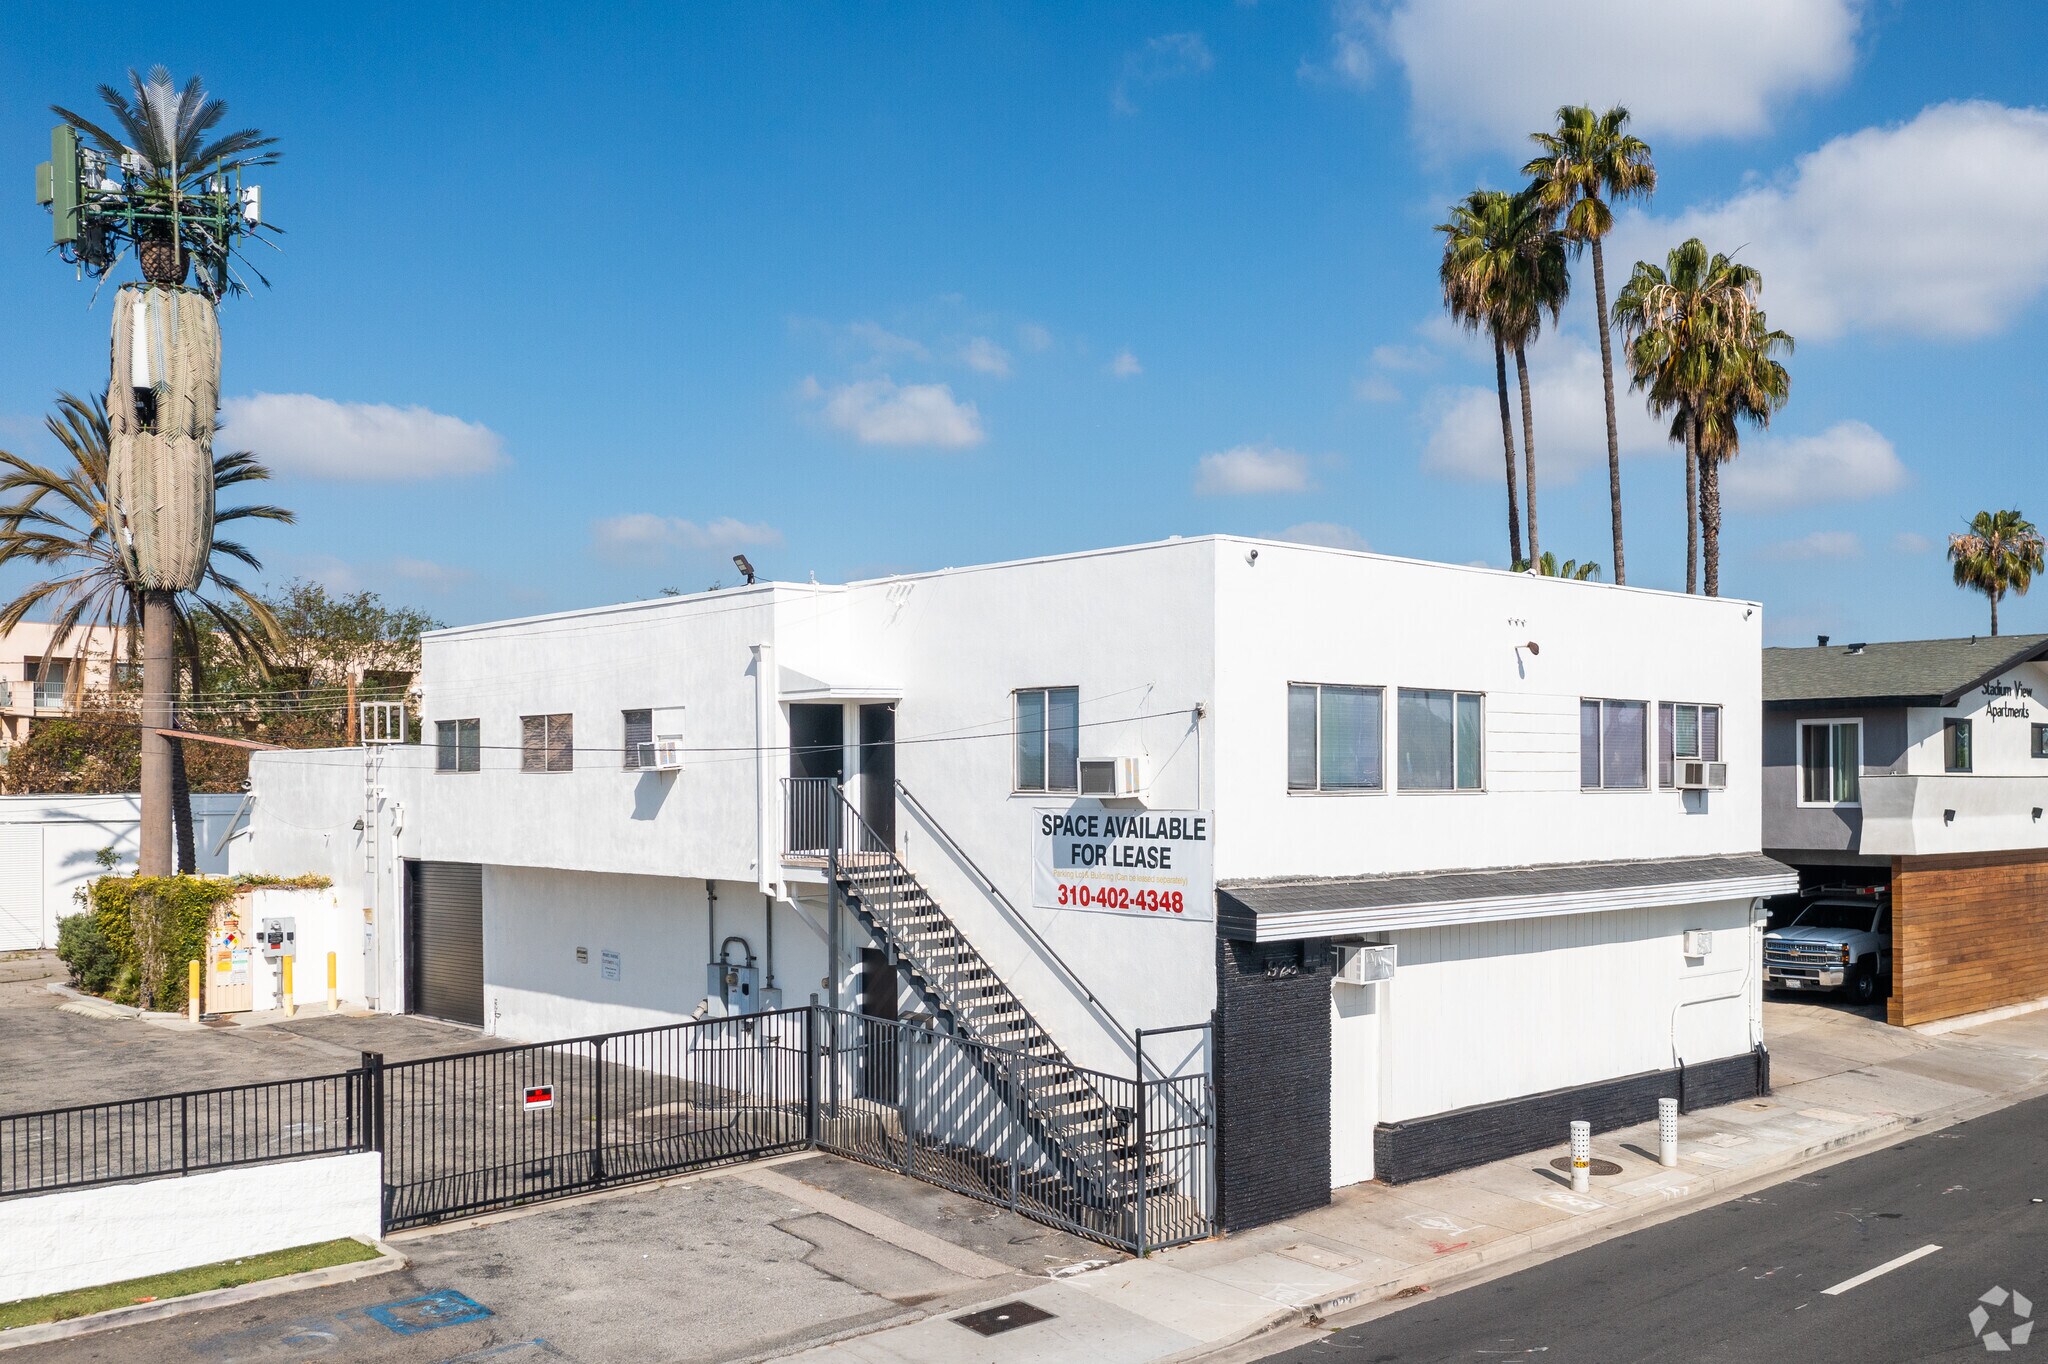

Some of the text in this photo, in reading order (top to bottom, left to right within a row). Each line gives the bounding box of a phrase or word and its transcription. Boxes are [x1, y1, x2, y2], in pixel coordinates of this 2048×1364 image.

[1981, 679, 2033, 699] Stadium View
[1986, 700, 2030, 723] Apartments
[1042, 814, 1206, 841] SPACE AVAILABLE
[1071, 843, 1171, 869] FOR LEASE
[1058, 884, 1184, 913] 310-402-4348
